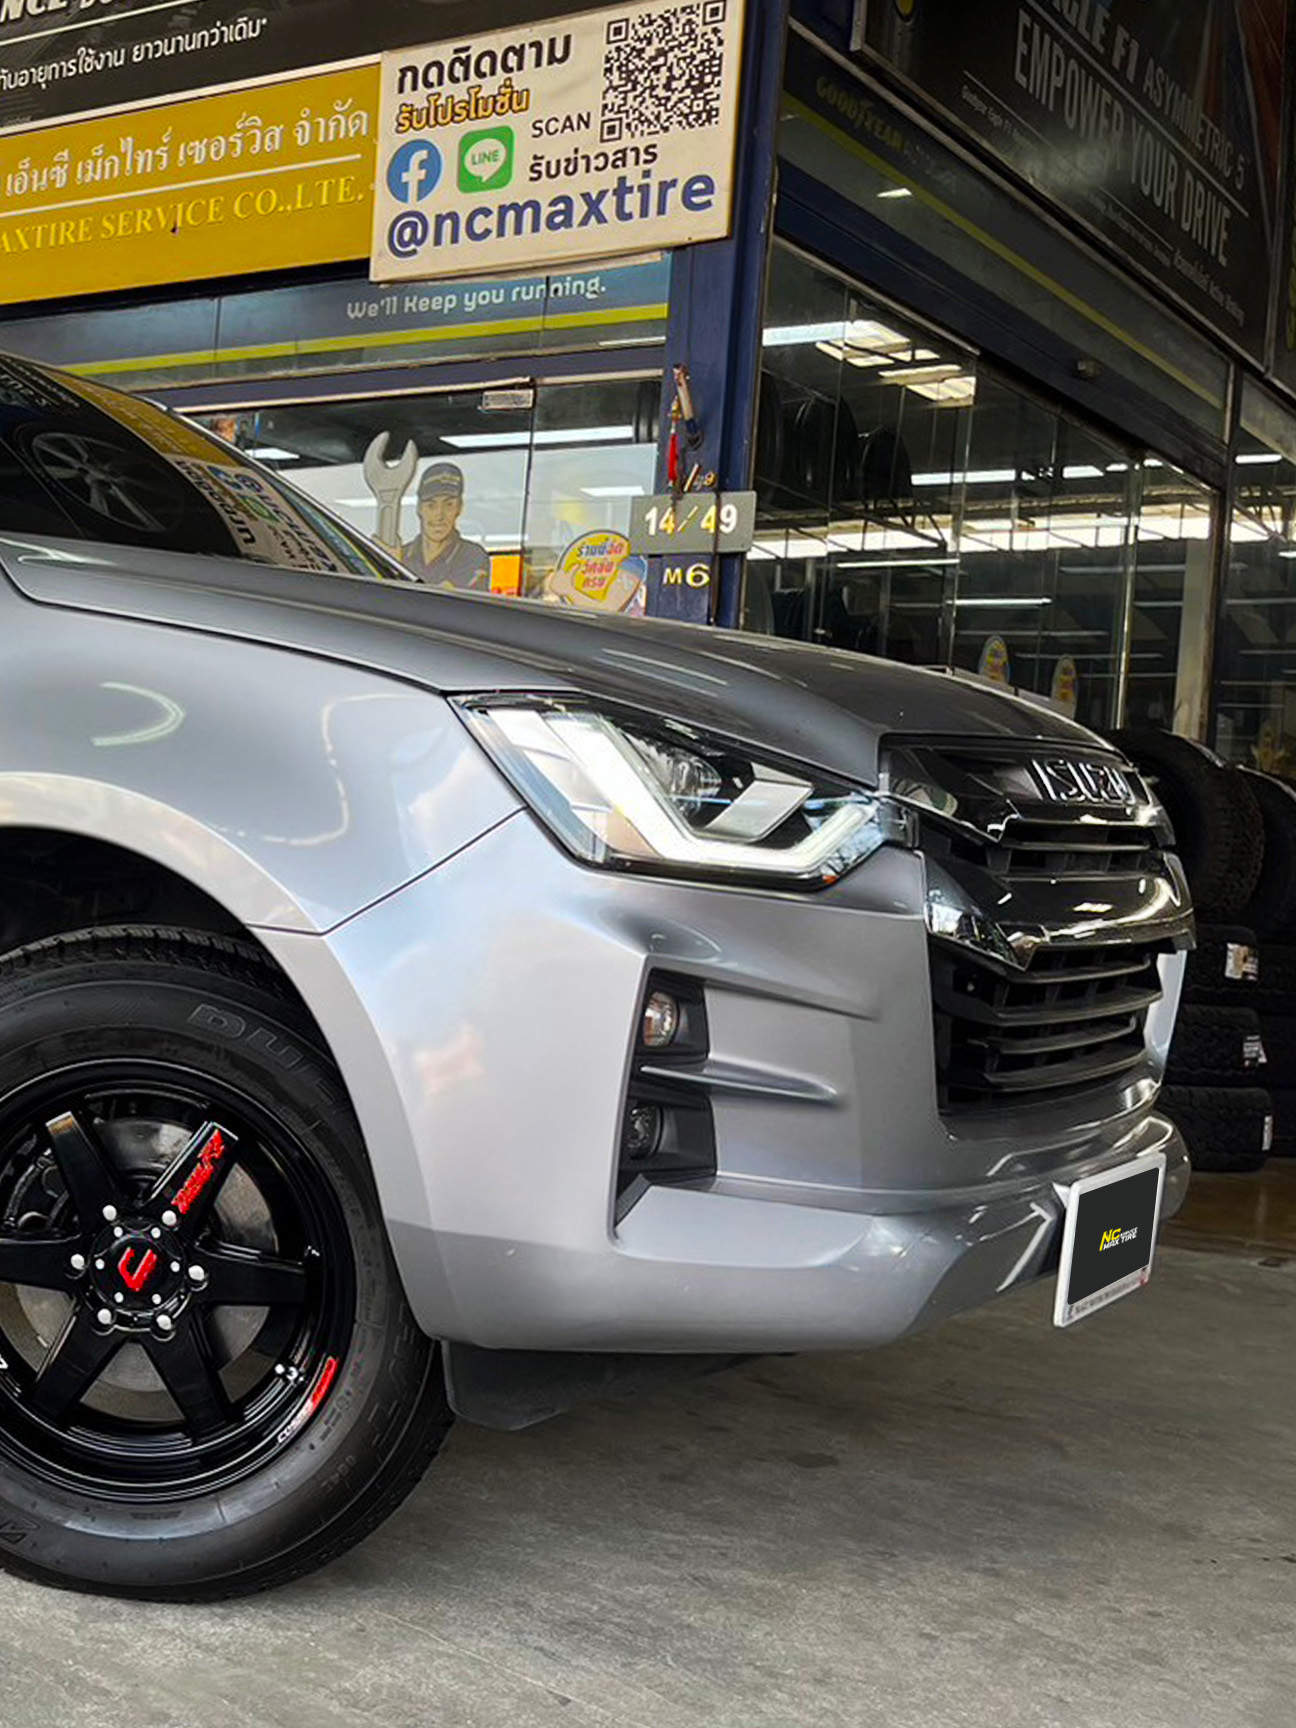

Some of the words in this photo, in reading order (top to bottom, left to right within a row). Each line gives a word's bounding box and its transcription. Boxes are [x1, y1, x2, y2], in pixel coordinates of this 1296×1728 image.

[396, 33, 573, 94] กดติดตาม
[396, 78, 531, 133] รับโปรโมชั่น
[531, 112, 592, 138] SCAN
[1142, 57, 1235, 178] ASYMMETRIC
[6, 148, 70, 197] เอ็นซี
[178, 112, 285, 167] เซอร์วิส
[294, 97, 370, 148] จำกัด
[471, 149, 500, 167] LINE
[528, 143, 659, 182] รับข่าวสาร
[1012, 8, 1127, 170] EMPOWER
[1130, 116, 1180, 219] YOUR
[1180, 168, 1232, 267] DRIVE
[101, 196, 225, 241] SERVICE
[387, 170, 716, 259] @ncmaxtire
[347, 296, 397, 319] We'll
[464, 287, 505, 312] you
[644, 503, 738, 536] 14/49
